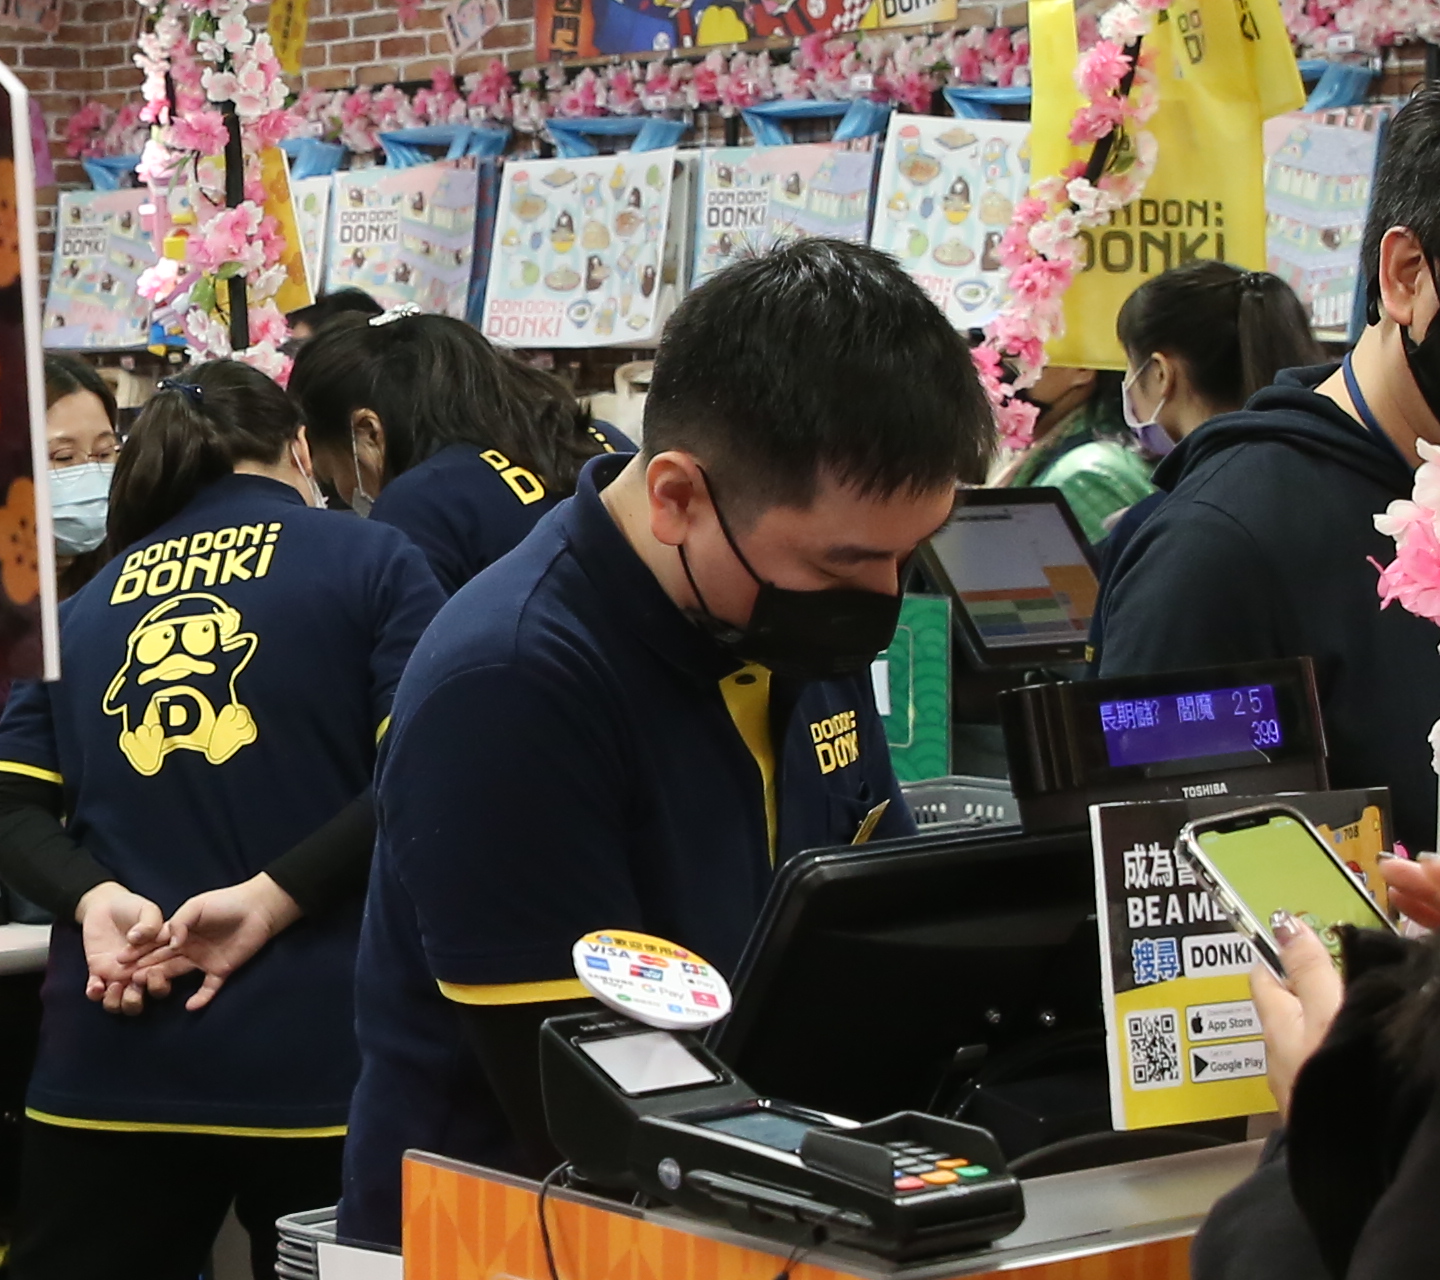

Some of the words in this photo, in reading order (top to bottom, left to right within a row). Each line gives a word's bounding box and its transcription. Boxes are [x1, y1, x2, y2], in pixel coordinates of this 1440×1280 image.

[339, 223, 400, 245] DONKI
[110, 542, 275, 607] DONKI
[1251, 719, 1280, 746] 399
[1181, 782, 1229, 799] TOSHIBA
[1126, 894, 1163, 930] BE
[1164, 893, 1184, 926] A
[587, 943, 632, 960] VISA
[1131, 936, 1181, 984] 搜尋
[1191, 936, 1253, 967] DONKI
[1207, 1018, 1228, 1035] App
[1229, 1014, 1254, 1031] Store
[1209, 1057, 1237, 1075] Google
[1239, 1054, 1265, 1072] Play
